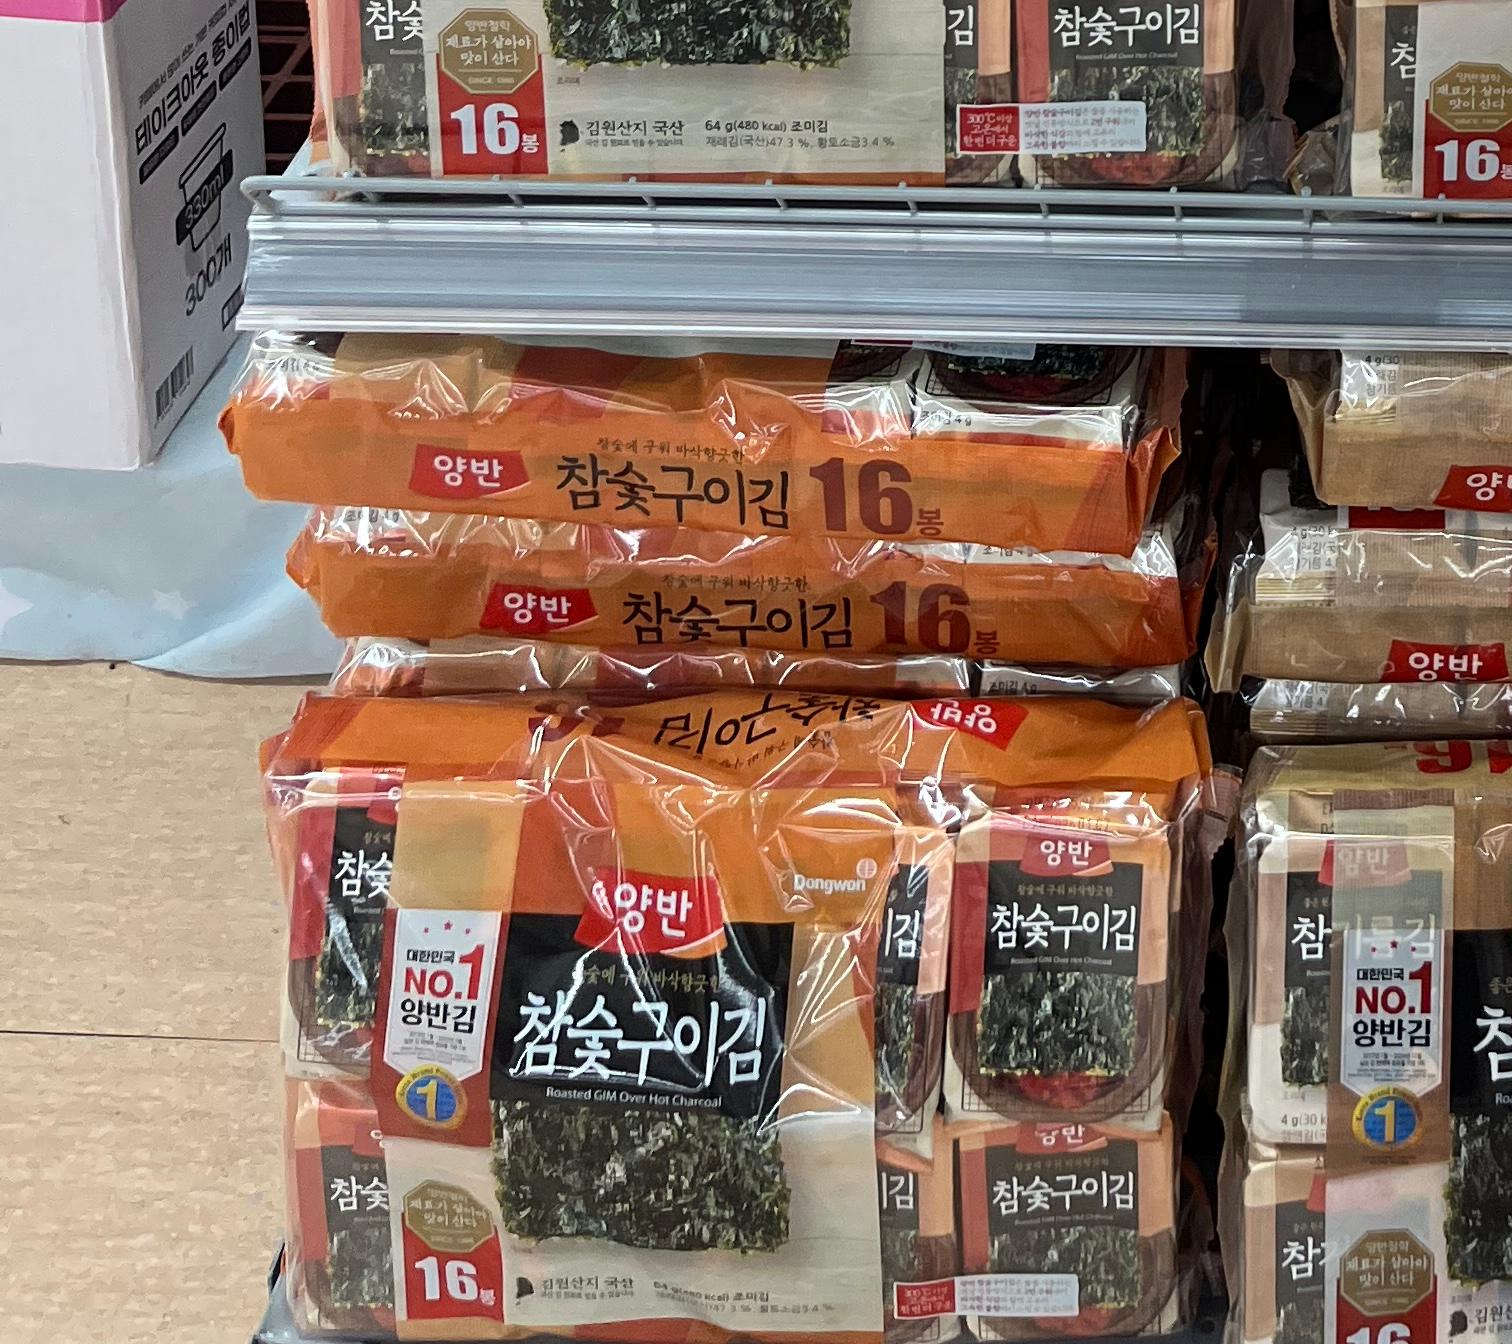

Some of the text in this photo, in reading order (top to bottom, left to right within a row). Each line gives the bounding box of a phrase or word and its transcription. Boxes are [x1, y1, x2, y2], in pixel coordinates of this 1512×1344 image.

[1054, 2, 1200, 50] 참숯구이김
[134, 0, 252, 155] 테이크아웃 종이컵
[586, 118, 685, 138] 김원산지 국산
[183, 164, 226, 232] 330ml
[184, 232, 233, 317] 300개
[642, 438, 671, 457] 구워
[432, 453, 945, 537] 양반 참숯구이김 16봉
[503, 588, 573, 627] 양반
[622, 590, 854, 652] 참숯구이김
[1409, 647, 1483, 683] 양반
[793, 872, 866, 894] Dongwon
[991, 902, 1137, 952] 참숯구이김
[406, 948, 455, 964] 대한민국
[1357, 968, 1405, 982] 대한민국
[512, 990, 767, 1088] 참숯구이김
[545, 1087, 721, 1108] Roasted GIM Over Hot Charcoal
[993, 1170, 1134, 1215] 참숯구이김
